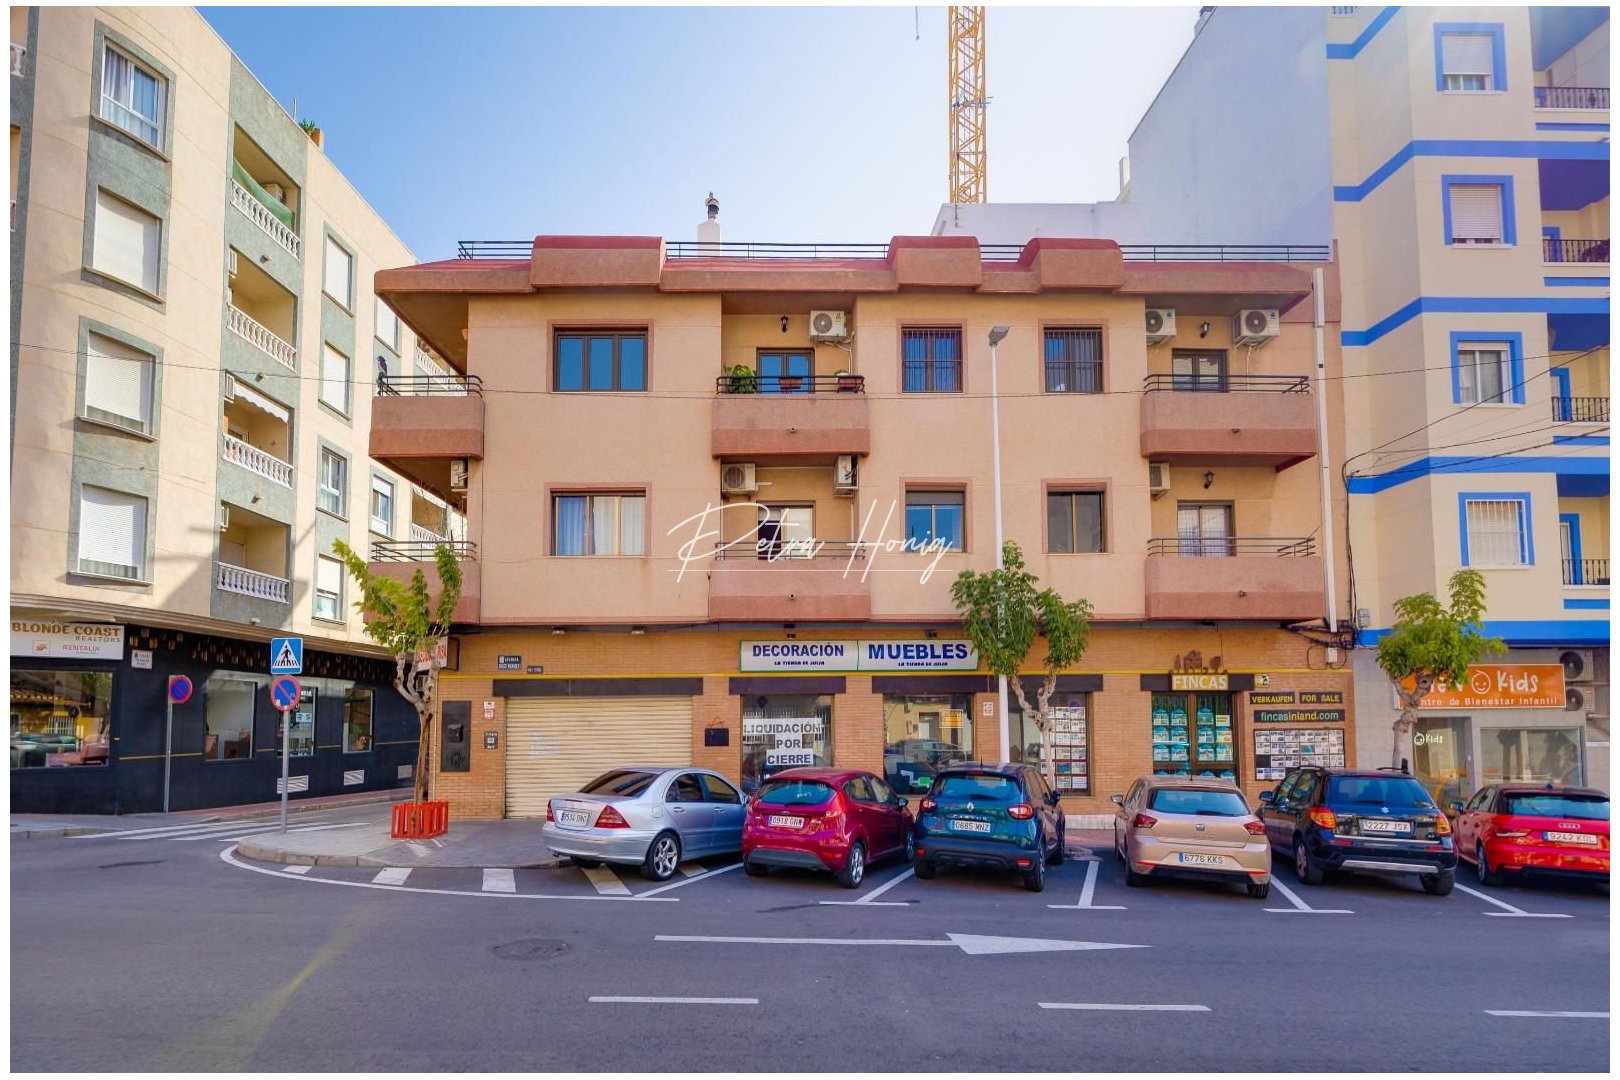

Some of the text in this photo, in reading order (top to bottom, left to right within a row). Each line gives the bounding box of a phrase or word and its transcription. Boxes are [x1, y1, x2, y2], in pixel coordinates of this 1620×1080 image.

[11, 622, 120, 637] BLONDE COAST
[75, 635, 121, 643] REALTORS
[752, 642, 844, 657] DECORACIÓN
[868, 643, 968, 660] MUEBLES
[1172, 675, 1228, 689] FINCAS
[1496, 670, 1539, 693] Kids
[1252, 695, 1293, 703] VERKAUFEN
[1301, 694, 1340, 703] FOR SALE
[1449, 697, 1460, 706] de
[1464, 697, 1515, 706] Bienestar
[1519, 697, 1558, 705] Infantil
[744, 721, 821, 734] LIQUIDACIÓN
[776, 739, 801, 749] POR
[767, 754, 812, 764] CIERRE
[1368, 821, 1390, 830] 2227
[1184, 853, 1206, 863] 6776
